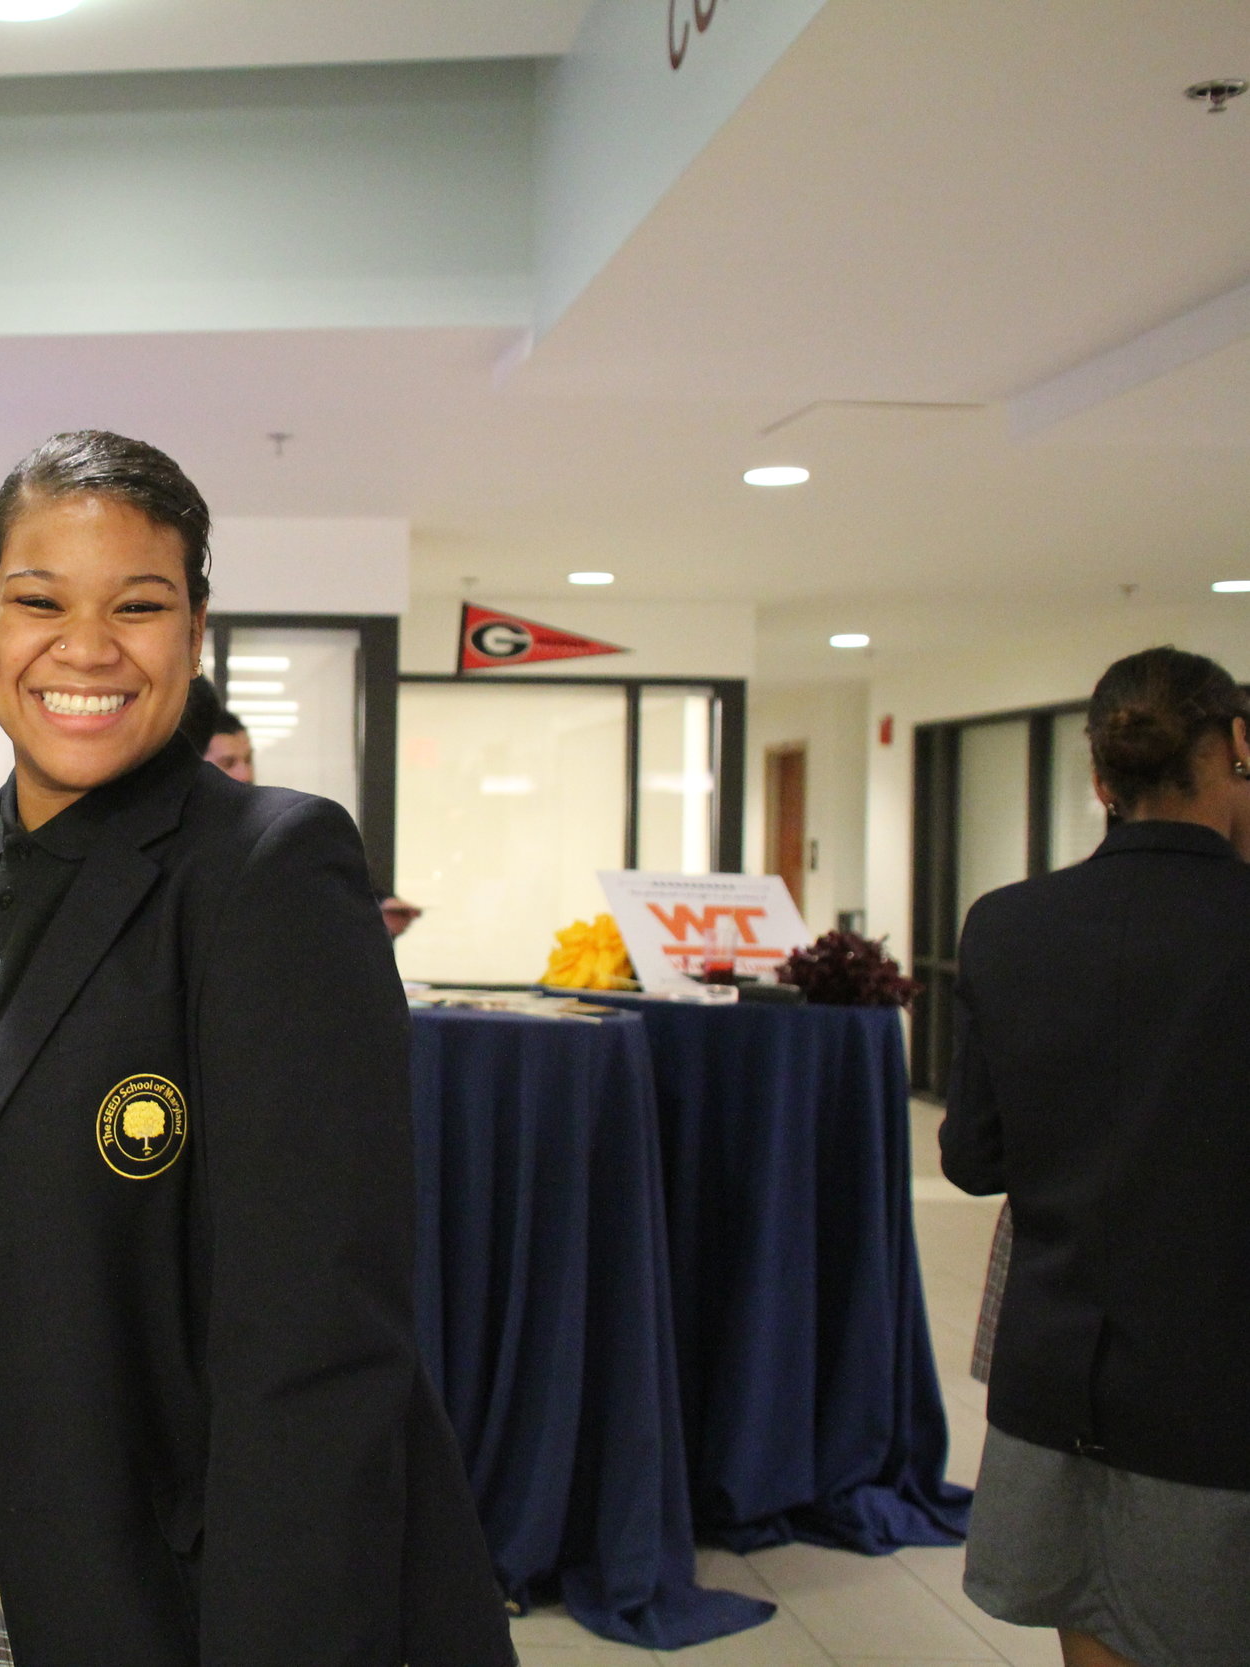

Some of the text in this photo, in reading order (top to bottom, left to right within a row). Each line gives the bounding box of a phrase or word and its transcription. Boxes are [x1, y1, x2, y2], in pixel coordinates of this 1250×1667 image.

[102, 1080, 183, 1147] The SEED School of Maryland
